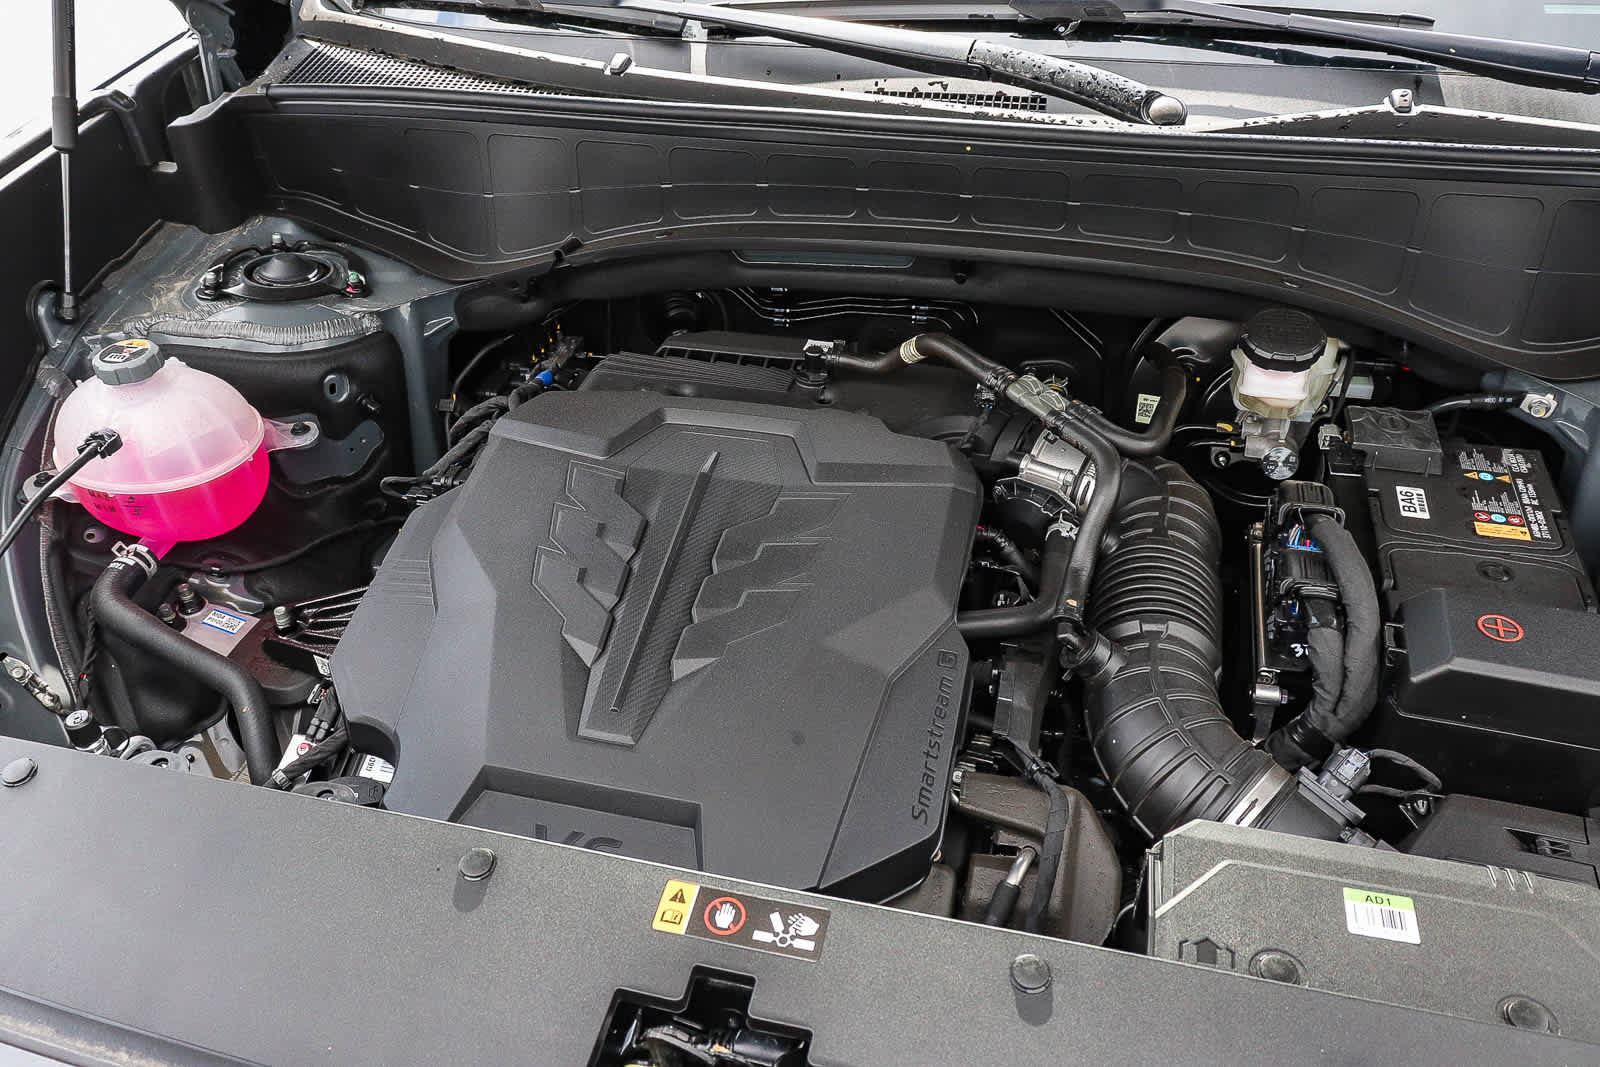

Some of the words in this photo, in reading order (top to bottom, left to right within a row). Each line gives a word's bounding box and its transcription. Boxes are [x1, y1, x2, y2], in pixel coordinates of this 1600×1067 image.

[1399, 490, 1416, 513] BA6
[912, 676, 954, 825] Smartstream
[1365, 895, 1391, 906] AD1
